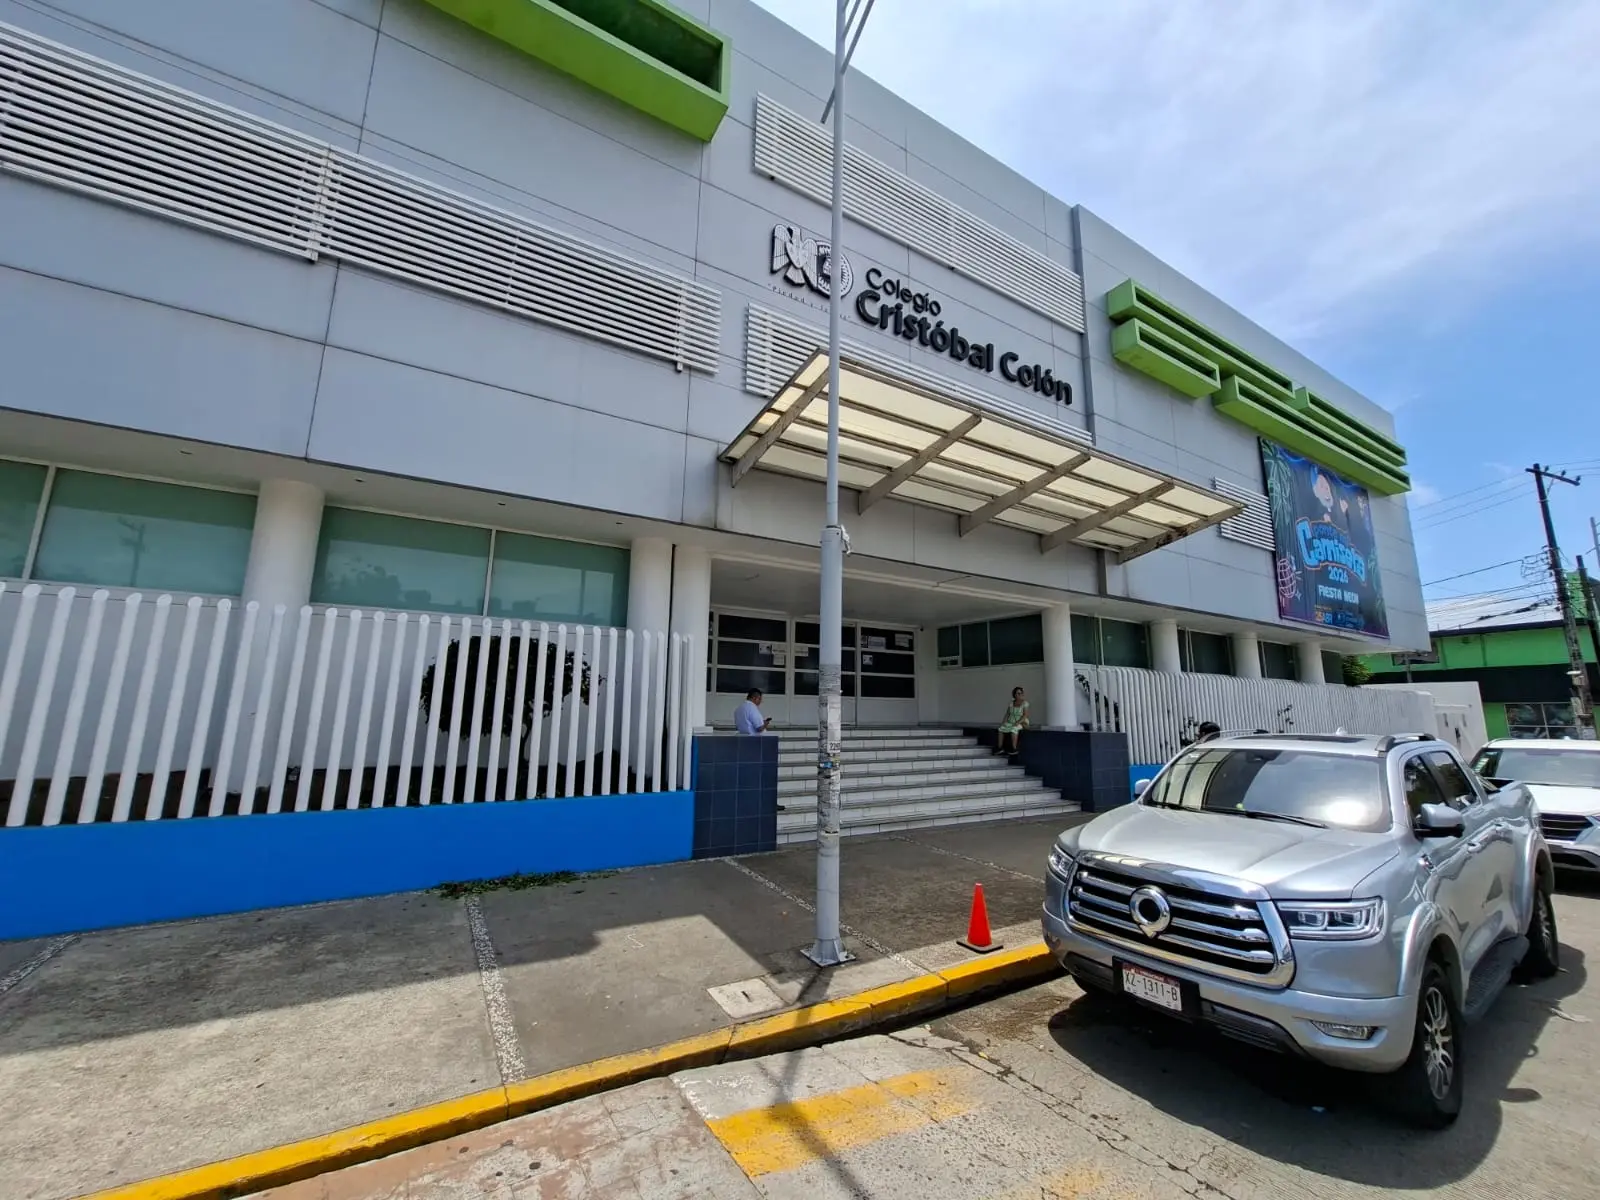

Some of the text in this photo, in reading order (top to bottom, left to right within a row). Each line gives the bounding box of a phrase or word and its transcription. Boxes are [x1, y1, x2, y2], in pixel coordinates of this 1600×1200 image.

[866, 268, 941, 316] Colegio
[856, 290, 1073, 405] Cristóbal Colón
[1318, 585, 1342, 600] FIESTA
[1125, 971, 1178, 1002] XZ-1311-B
